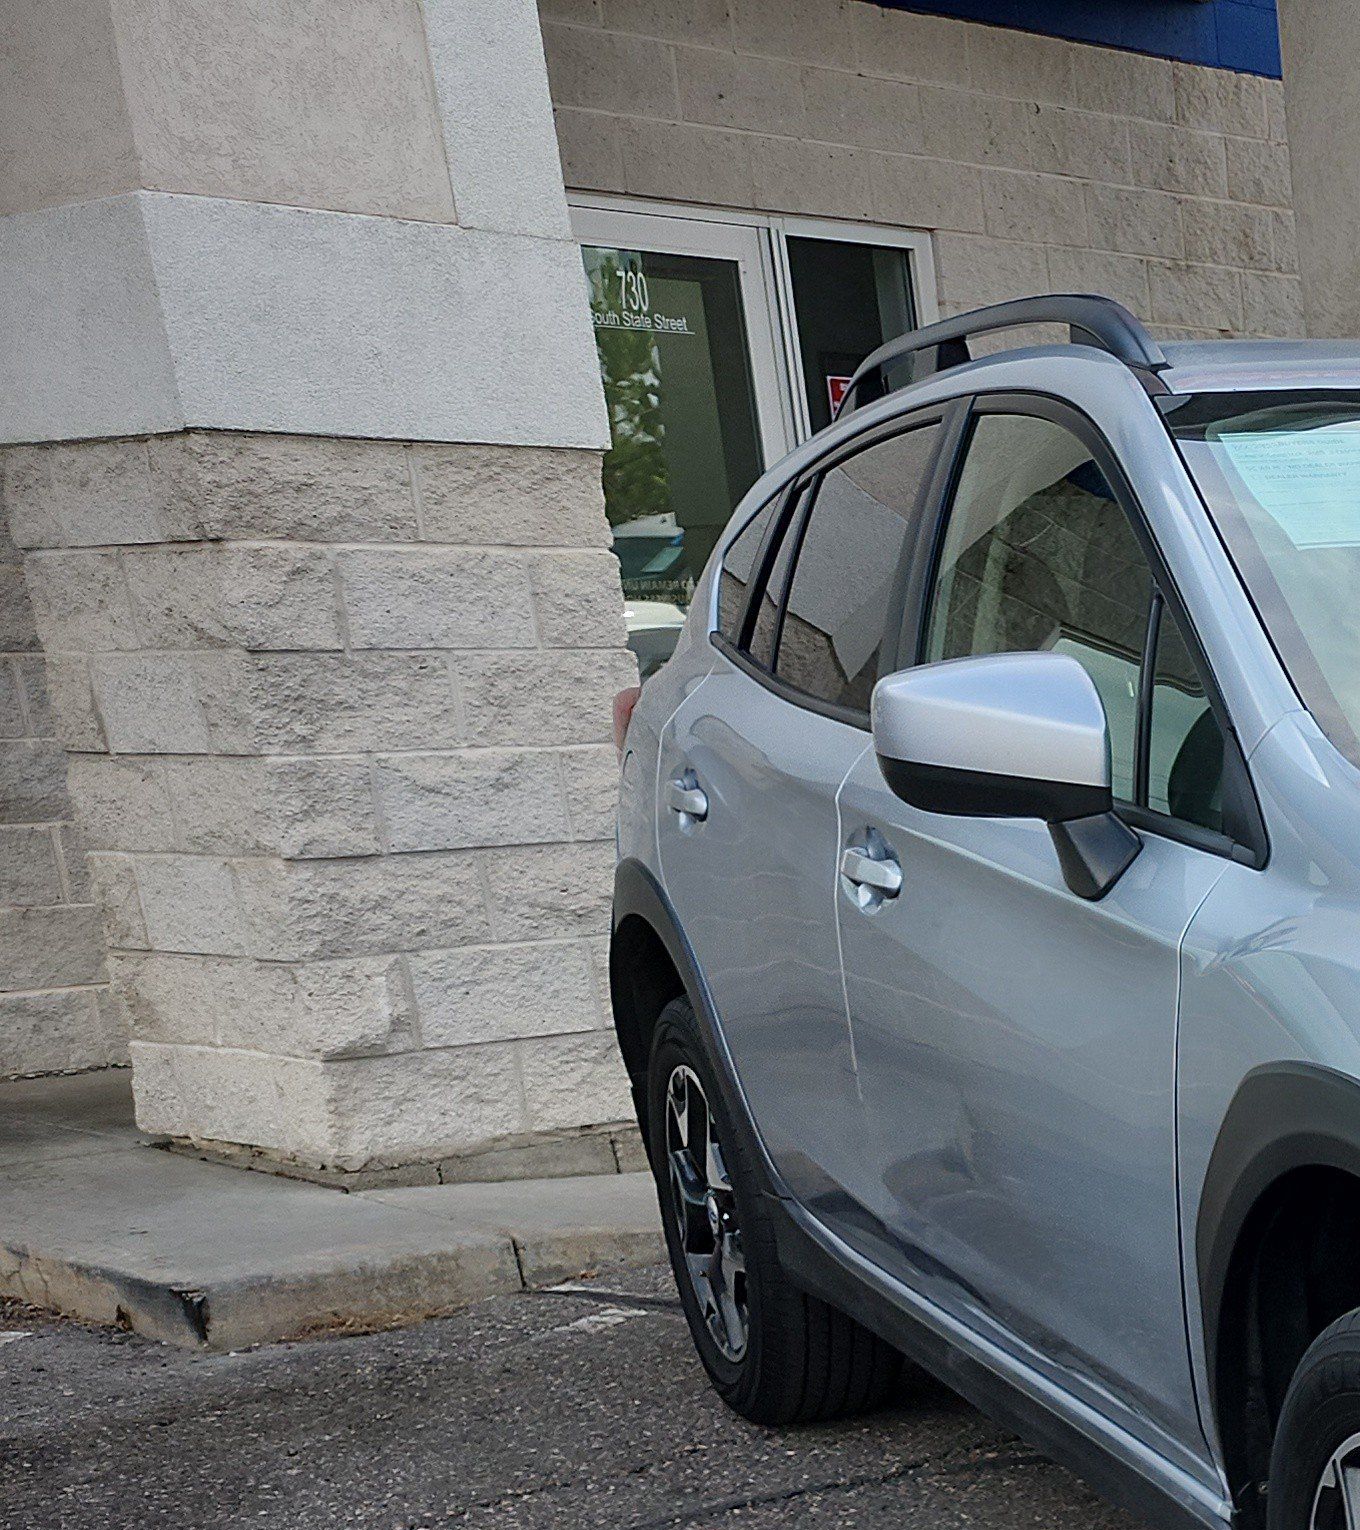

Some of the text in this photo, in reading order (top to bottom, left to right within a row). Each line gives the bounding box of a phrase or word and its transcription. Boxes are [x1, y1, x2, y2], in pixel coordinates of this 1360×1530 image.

[615, 270, 649, 312] 730
[622, 310, 652, 328] State
[653, 313, 688, 332] Street
